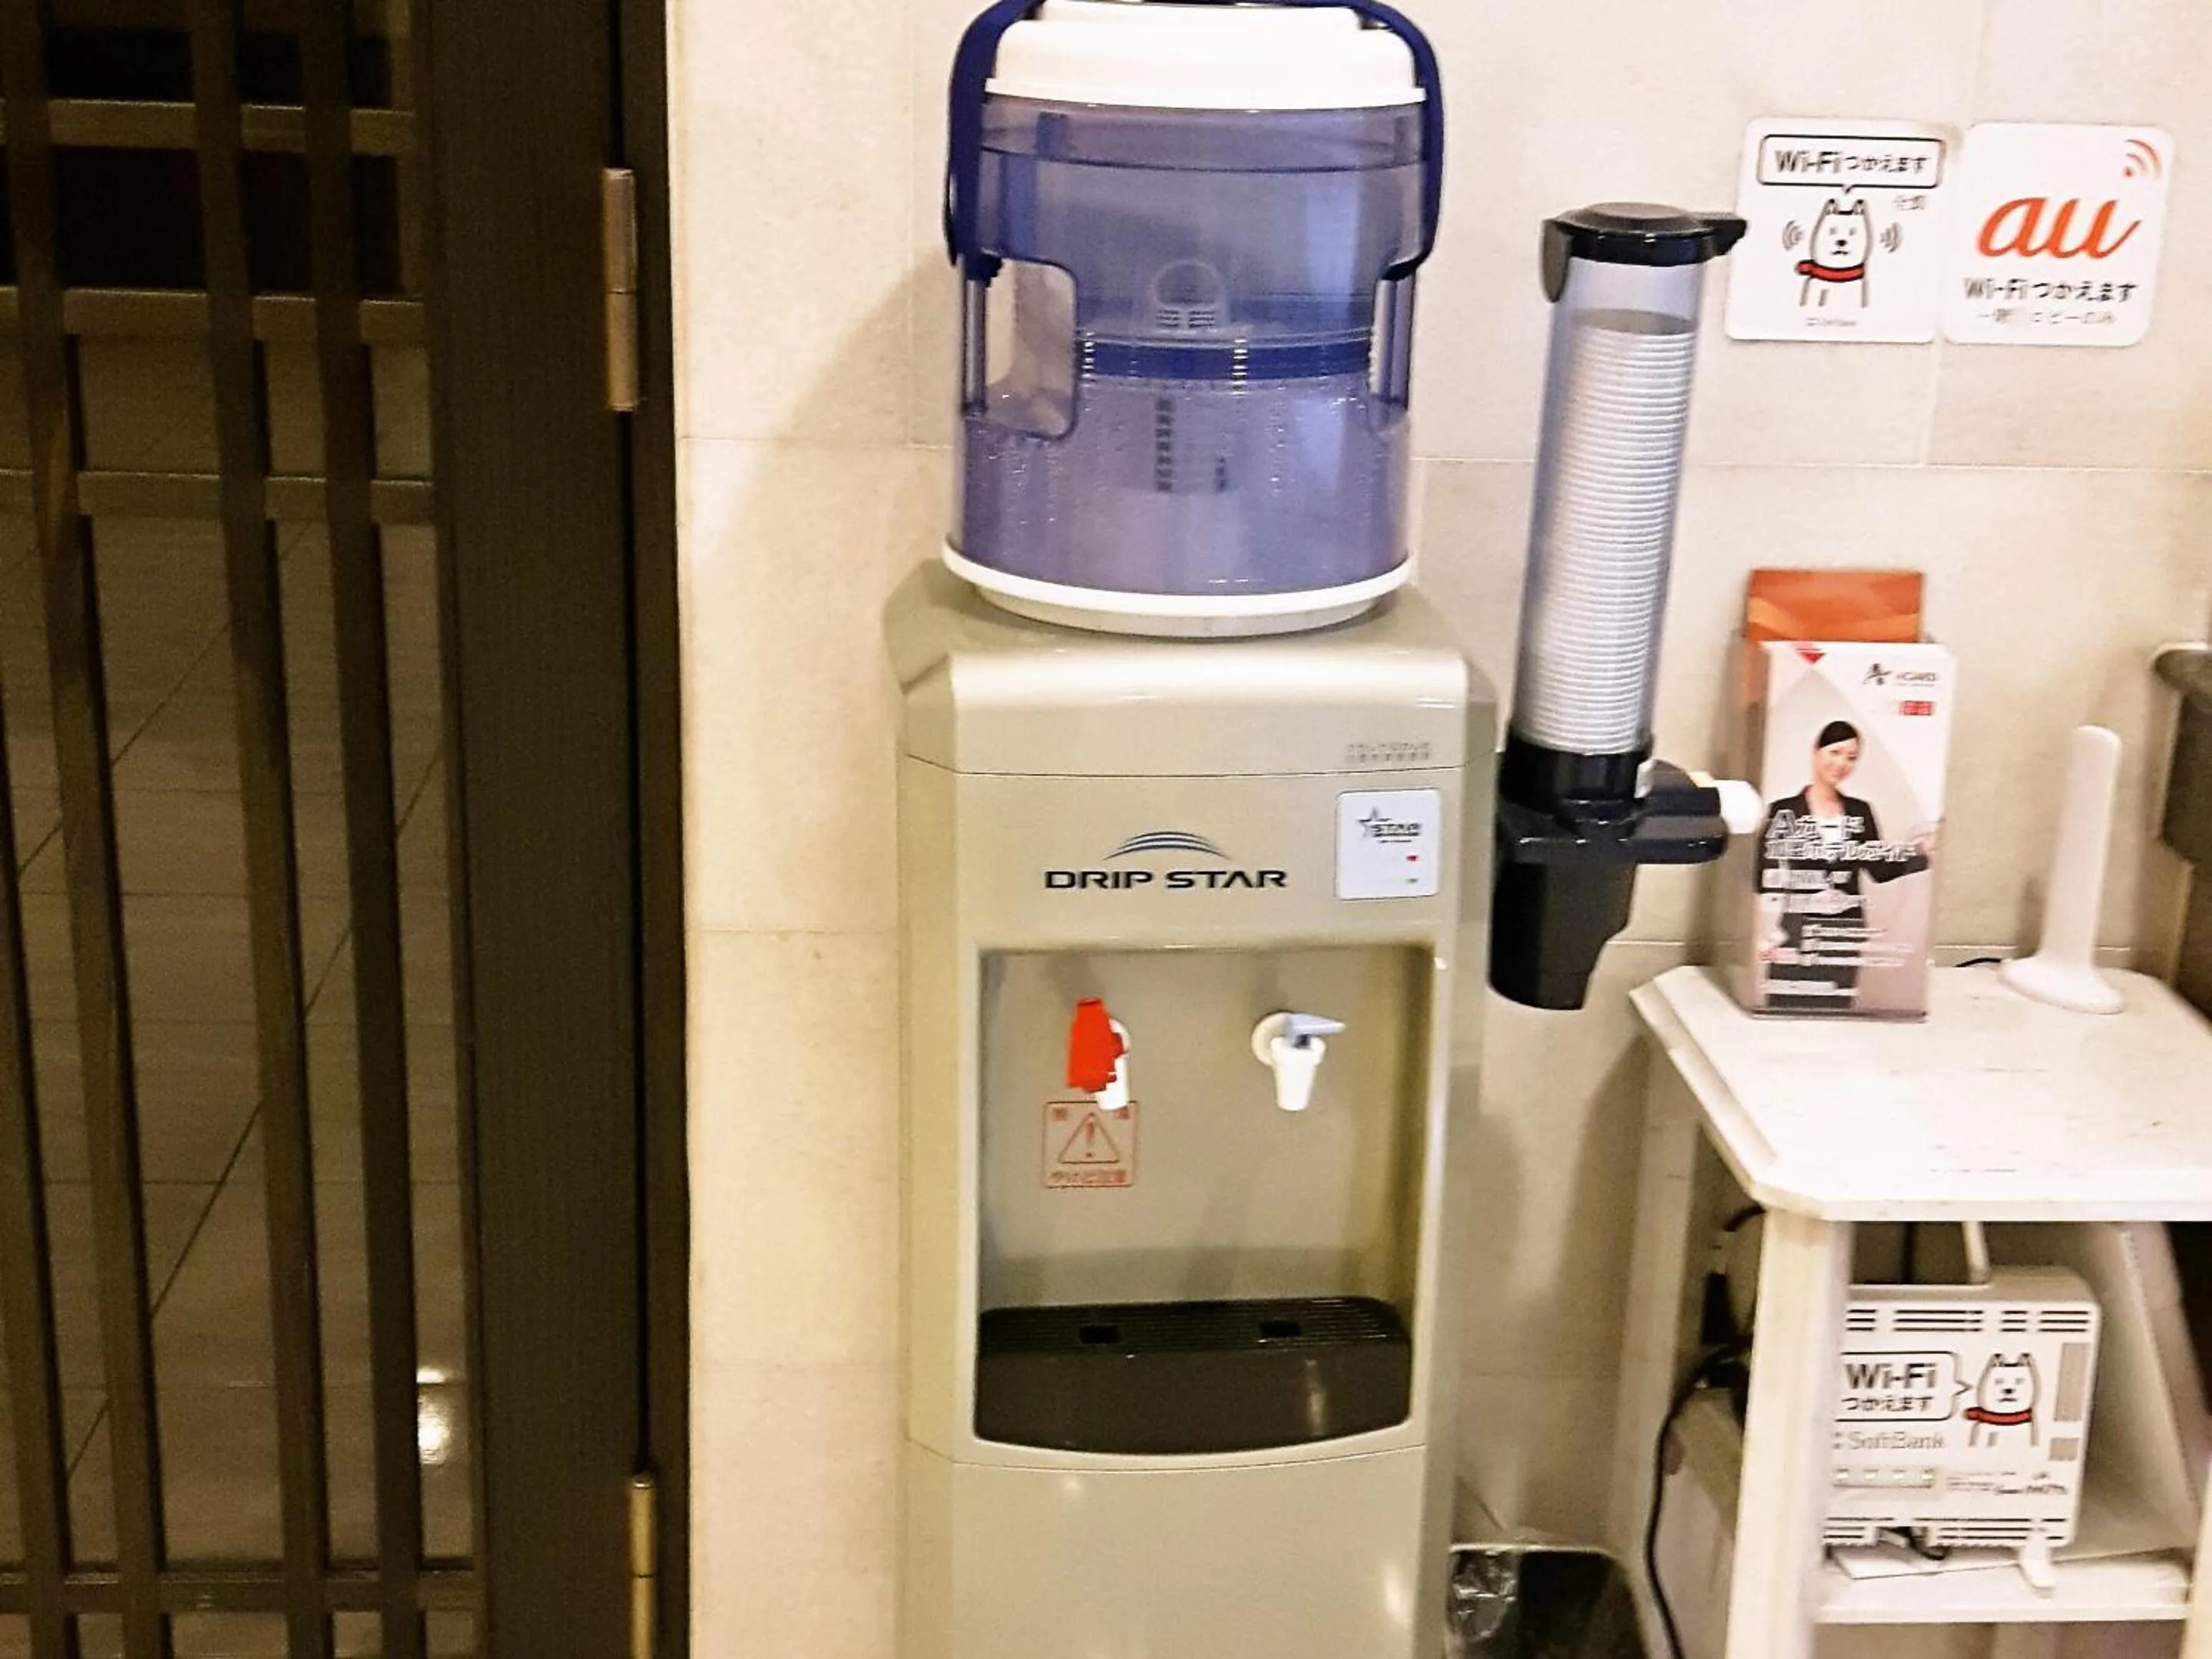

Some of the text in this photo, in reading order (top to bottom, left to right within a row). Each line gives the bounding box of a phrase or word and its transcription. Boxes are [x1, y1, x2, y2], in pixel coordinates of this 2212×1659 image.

[1977, 197, 2141, 260] au
[1045, 870, 1287, 889] DRIP STAR
[1844, 1363, 1937, 1389] Wi-Fi
[1841, 1395, 1933, 1412] つかえます
[1848, 1431, 1945, 1450] SoftBank
